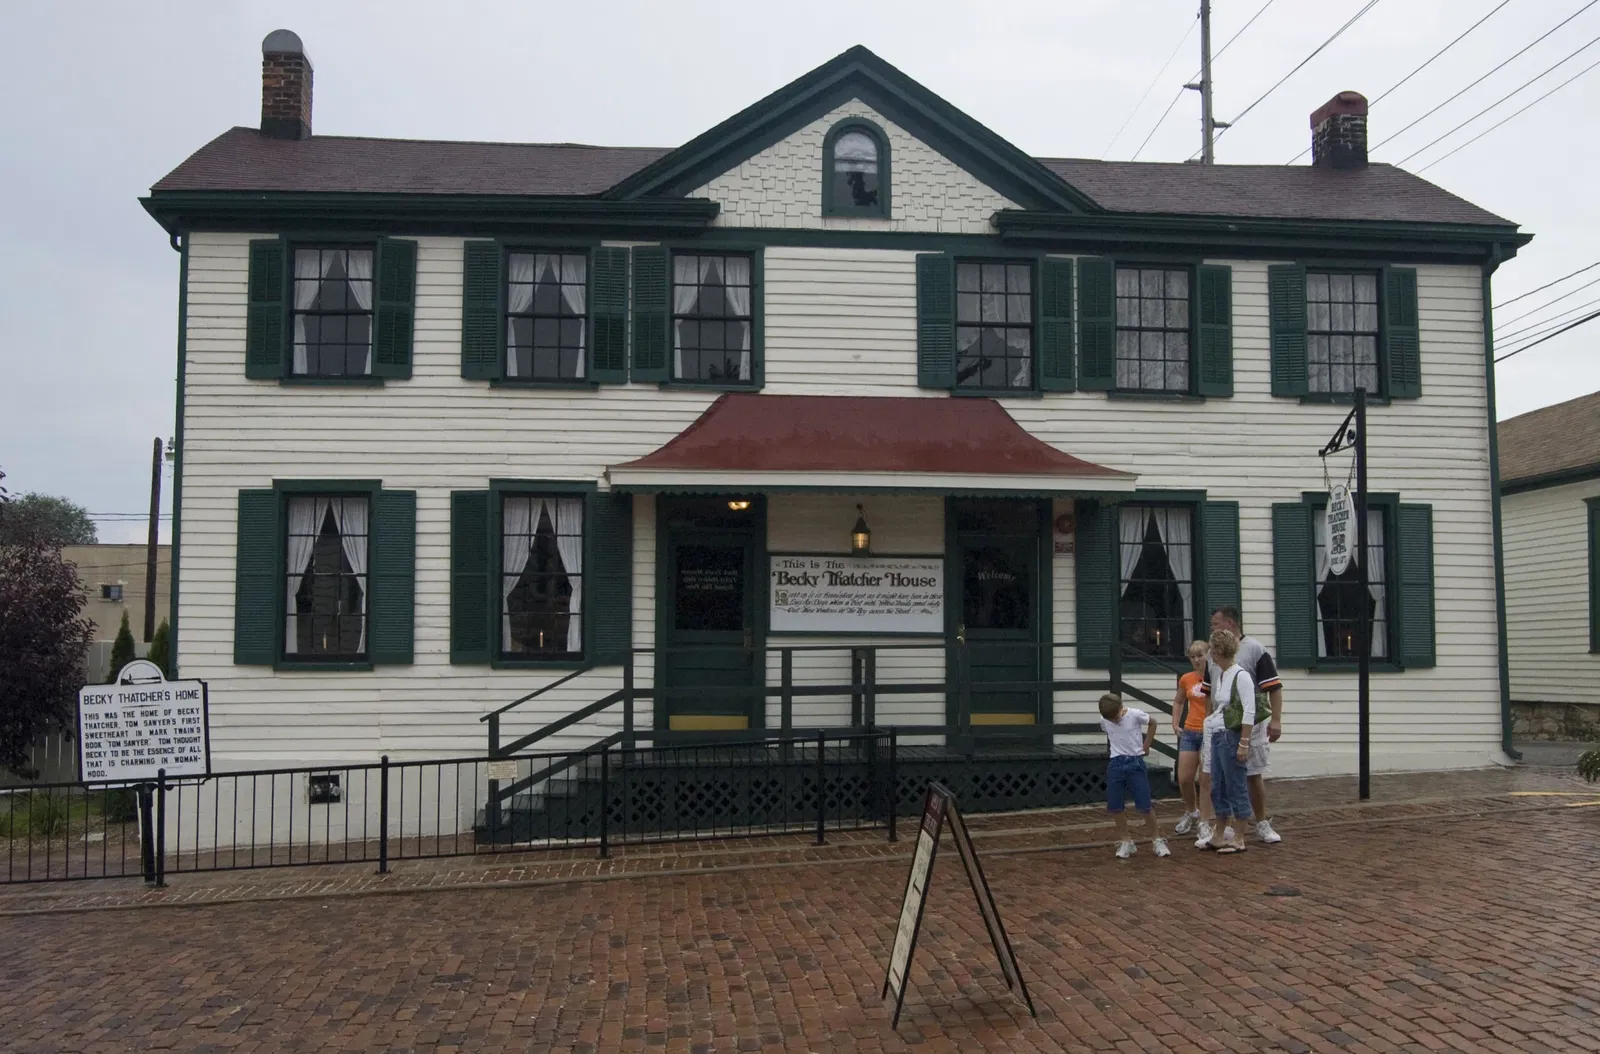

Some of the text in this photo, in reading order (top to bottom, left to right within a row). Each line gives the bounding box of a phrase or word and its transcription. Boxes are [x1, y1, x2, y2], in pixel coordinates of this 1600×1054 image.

[1332, 500, 1345, 512] BECKY
[1328, 510, 1349, 524] THATCHER
[1332, 522, 1346, 534] HOUSE
[782, 559, 845, 569] This is The
[772, 570, 936, 588] Becky Thatcher House
[978, 570, 1016, 582] Welcome
[84, 689, 200, 705] BECKY THATCHER'S HOME
[141, 710, 158, 718] HOME
[125, 720, 138, 728] TOM
[144, 718, 176, 727] SAWYER'S
[85, 730, 128, 739] SWEETHEART
[174, 726, 200, 734] TWAIN'S
[85, 741, 102, 749] BOOK
[158, 737, 171, 745] TOM
[174, 736, 201, 744] THOUGHT
[86, 750, 107, 758] BECKY
[122, 749, 130, 757] BE
[133, 748, 145, 756] THE
[148, 747, 175, 755] ESSENCE
[189, 745, 201, 753] ALL
[86, 760, 102, 768] THAT
[121, 757, 155, 766] CHARMING
[175, 755, 201, 763] WOMAN-
